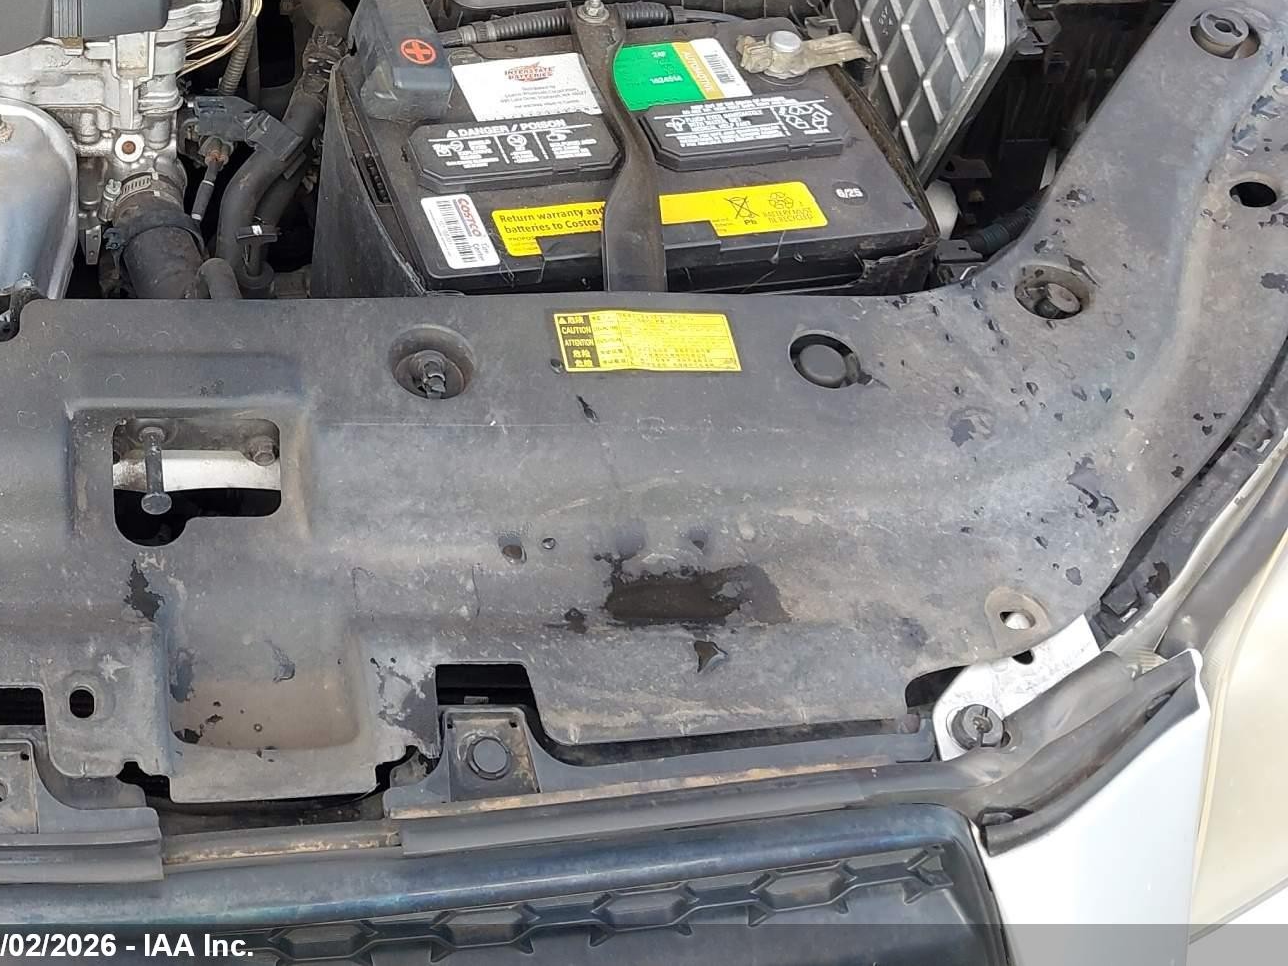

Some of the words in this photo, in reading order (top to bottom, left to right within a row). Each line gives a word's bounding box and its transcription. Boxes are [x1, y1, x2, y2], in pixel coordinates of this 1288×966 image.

[458, 125, 509, 137] DANGER
[520, 119, 566, 130] POISON
[835, 188, 863, 199] 6/25
[457, 198, 482, 238] COSTCO
[499, 214, 534, 223] Return
[537, 209, 584, 221] warranty
[586, 205, 604, 215] and
[504, 222, 551, 234] batteries
[552, 222, 563, 230] to
[566, 218, 599, 229] Costco
[561, 326, 592, 335] CAUTION
[564, 338, 595, 346] ATTENTION
